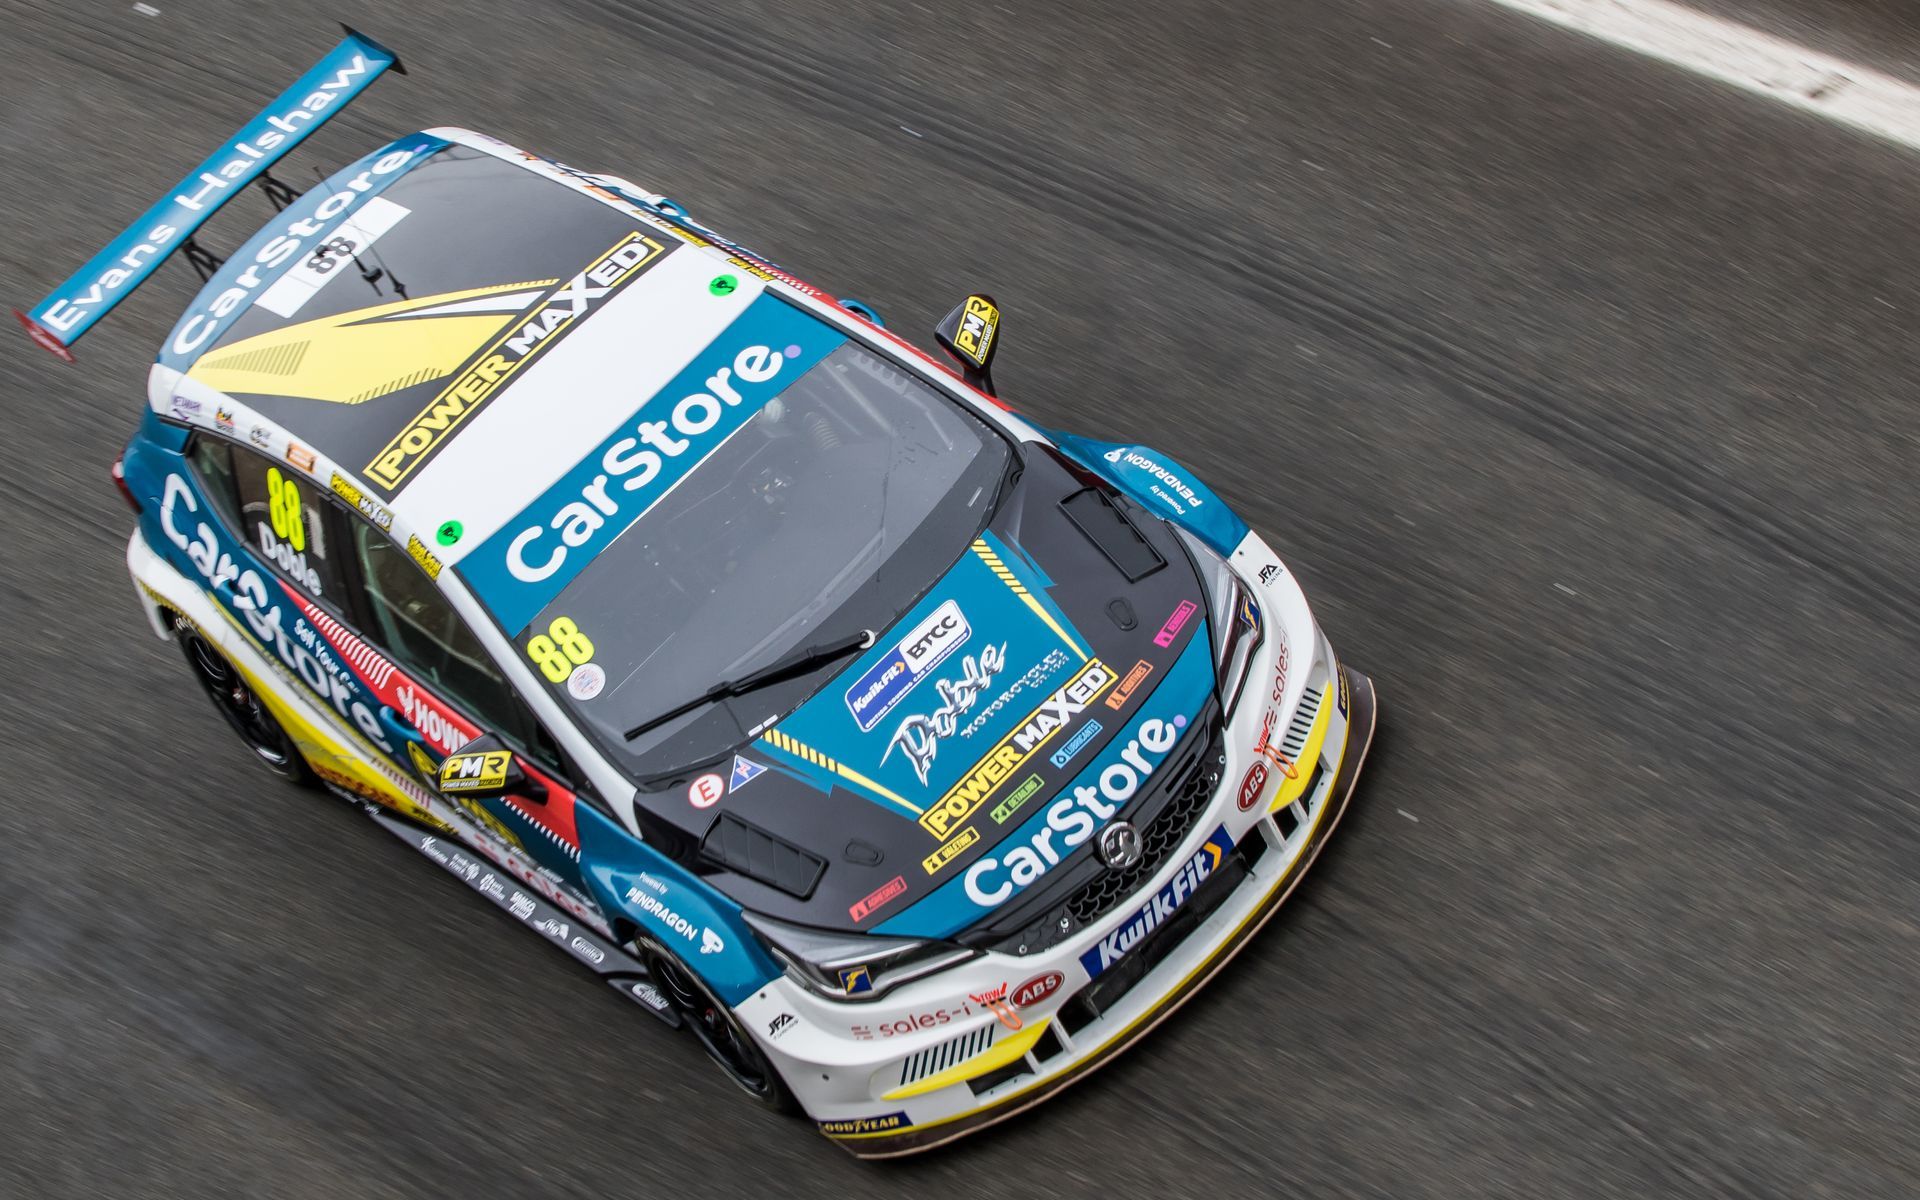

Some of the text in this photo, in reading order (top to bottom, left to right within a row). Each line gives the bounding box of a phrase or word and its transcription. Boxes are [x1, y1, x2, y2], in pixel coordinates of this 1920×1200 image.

[41, 55, 366, 332] Evans Halshaw
[306, 236, 357, 275] 88
[958, 299, 989, 353] PMR
[373, 242, 649, 480] POWER MAXED
[1123, 452, 1203, 508] PENDRAGON
[1149, 485, 1186, 516] Powered by
[267, 467, 305, 551] 88
[258, 521, 322, 597] Doble
[1258, 563, 1279, 585] JFA
[1265, 567, 1284, 588] TUNING
[527, 616, 595, 684] 88
[906, 615, 958, 660] BTCC
[960, 648, 1064, 739] MOTORCYCLES
[927, 667, 1108, 835] POWER MAXED
[1065, 721, 1099, 756] LUBRICANTS
[443, 756, 505, 780] PMR
[1243, 765, 1265, 806] ABS
[697, 779, 715, 803] E
[625, 886, 699, 942] PENDRAGON
[1098, 850, 1210, 971] KwikFit
[1019, 974, 1057, 1005] ABS
[768, 1012, 795, 1037] JFA
[878, 1001, 973, 1039] sales-i
